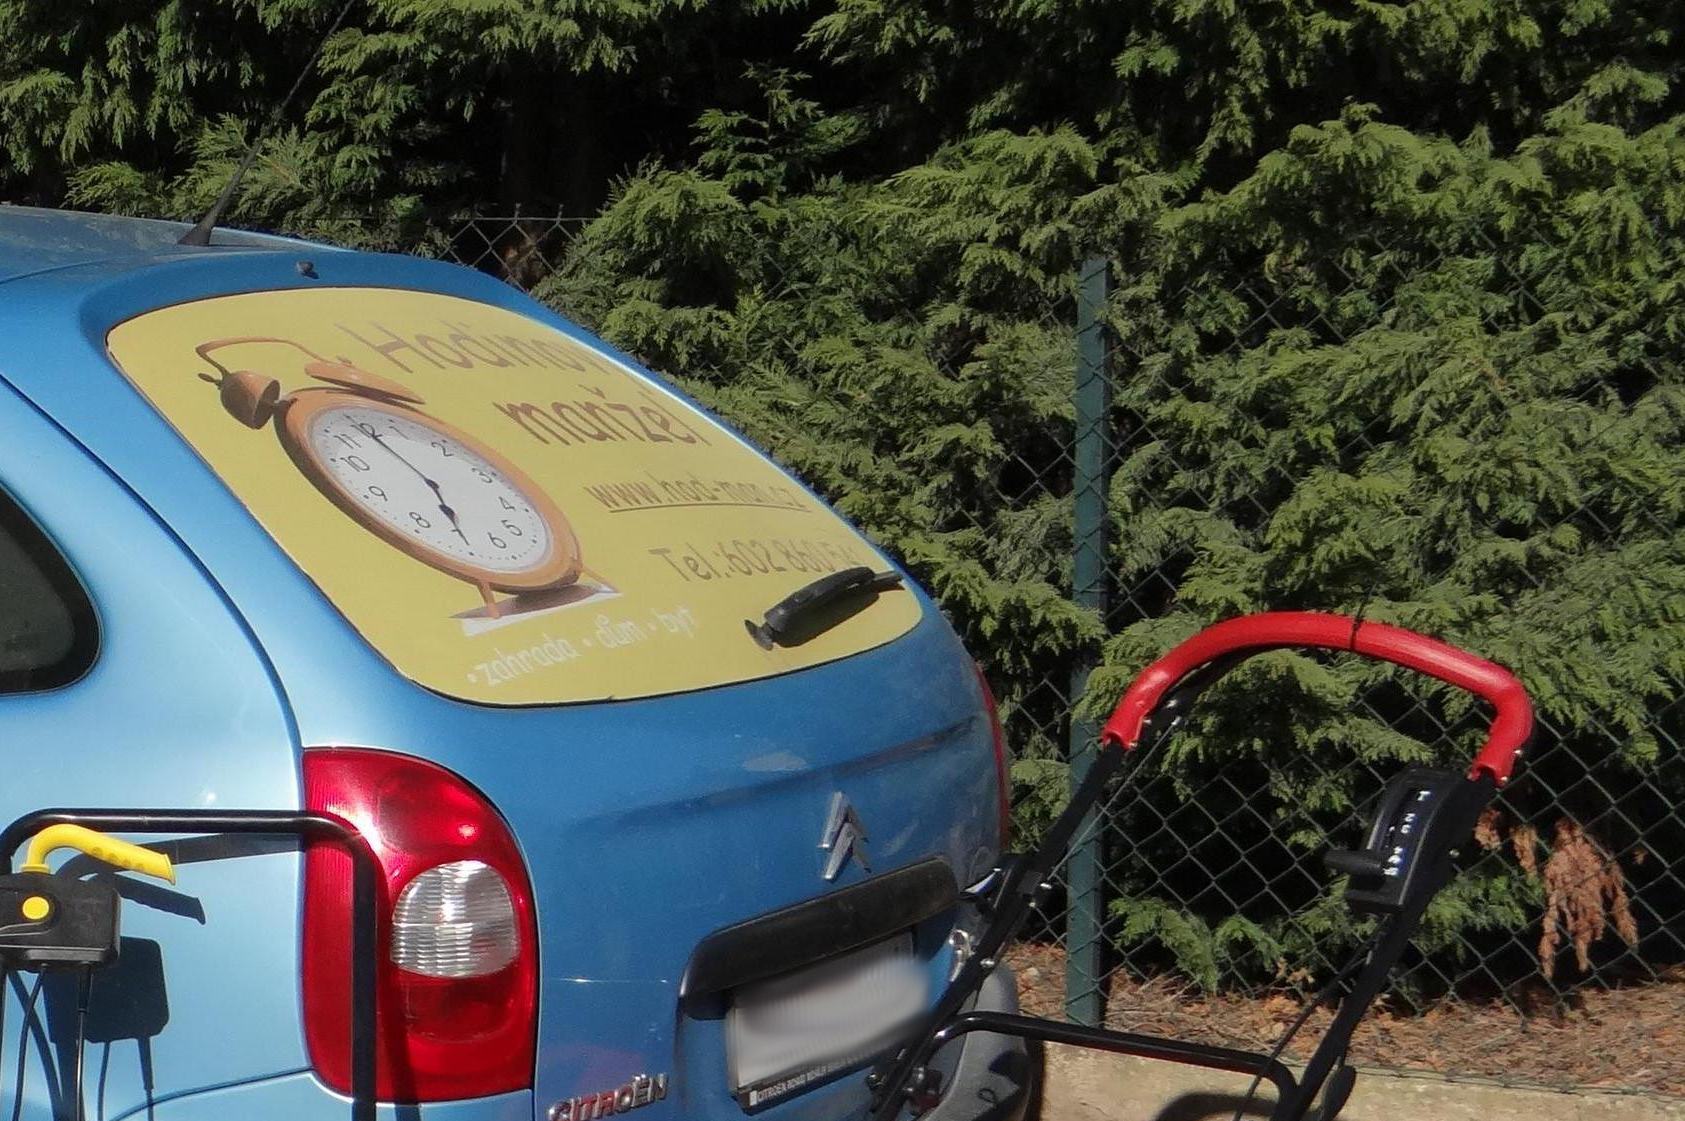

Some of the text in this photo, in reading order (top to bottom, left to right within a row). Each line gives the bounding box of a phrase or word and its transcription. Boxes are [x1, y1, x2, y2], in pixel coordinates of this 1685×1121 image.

[493, 382, 713, 446] manžel
[334, 433, 362, 450] 11
[431, 441, 454, 457] 2
[340, 455, 370, 472] 10
[471, 467, 493, 484] 3
[367, 485, 388, 502] 9
[498, 496, 516, 511] 4
[409, 511, 431, 529] 8
[501, 519, 523, 537] 5
[487, 532, 507, 549] 6
[475, 633, 581, 687] zahrada
